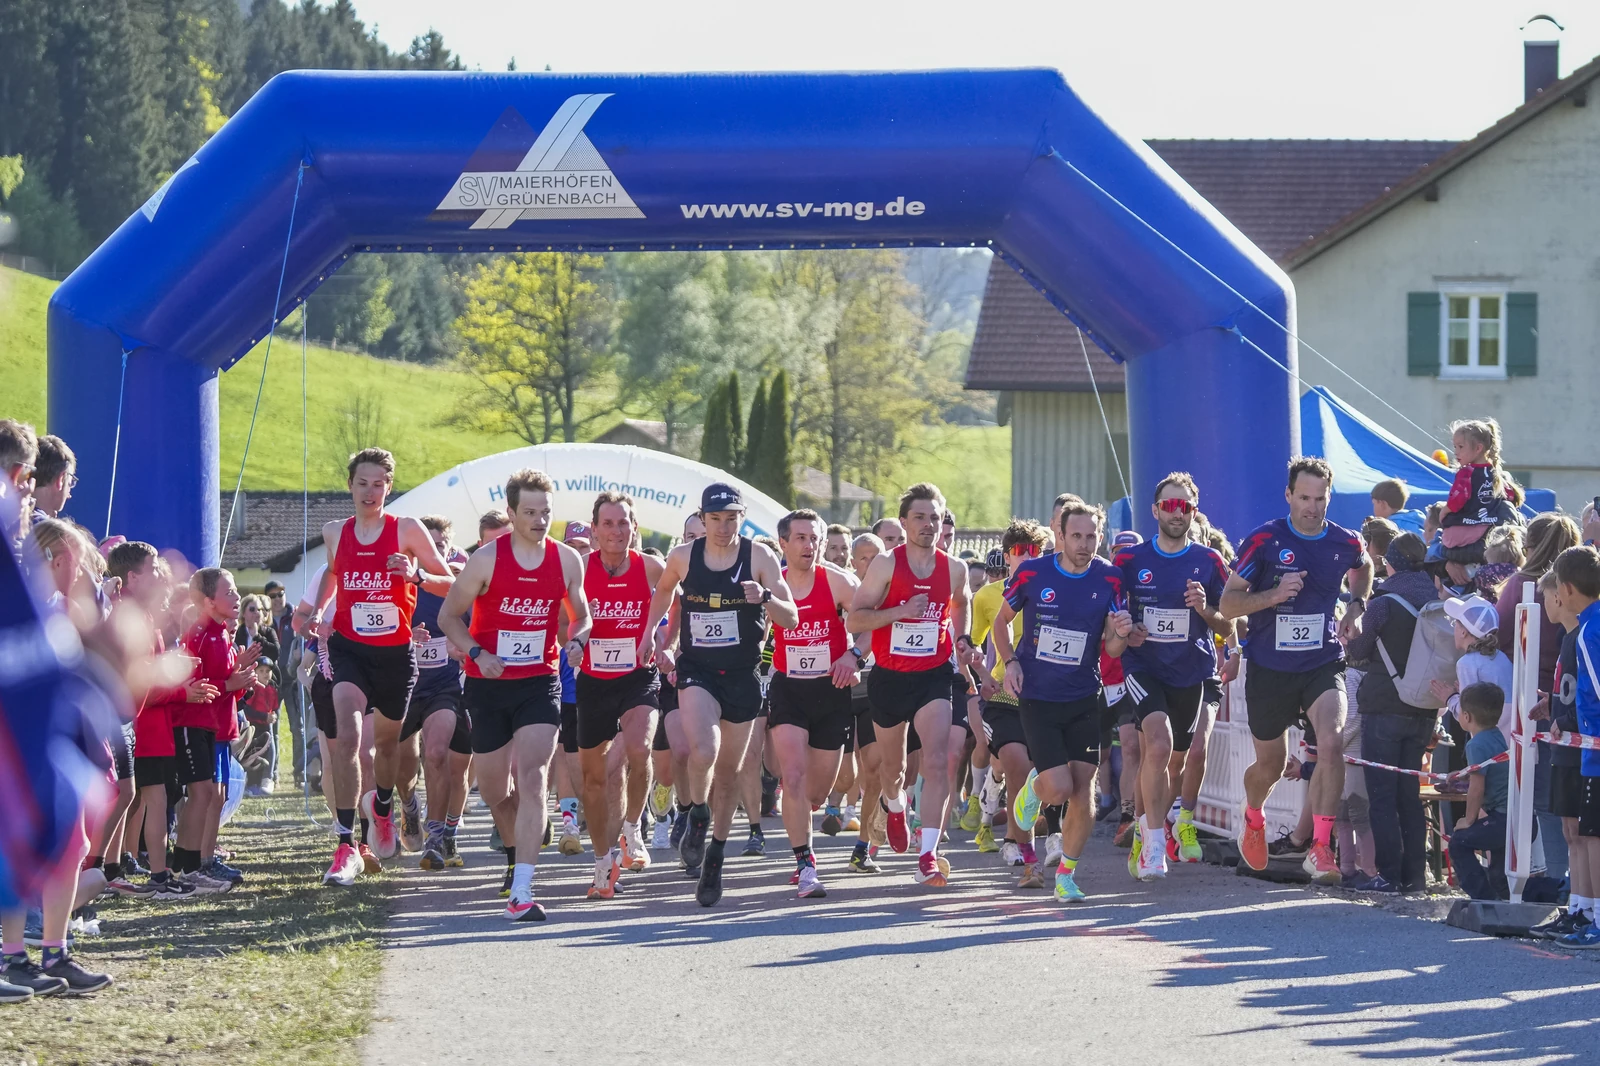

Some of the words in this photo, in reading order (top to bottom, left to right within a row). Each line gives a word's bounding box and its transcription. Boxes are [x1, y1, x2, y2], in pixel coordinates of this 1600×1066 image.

[500, 173, 612, 189] MAIERHÖFEN
[459, 176, 498, 206] SV
[497, 192, 616, 205] GRÜNENBACH
[680, 196, 926, 221] www.sv-mg.de
[565, 474, 686, 508] willkommen!
[343, 571, 392, 580] SPORT
[343, 580, 392, 588] HASCHKO
[366, 590, 393, 601] Team
[502, 597, 554, 606] SPORT
[499, 603, 550, 614] HASCHKO
[593, 601, 643, 610] SPORT
[593, 609, 642, 617] HASCHKO
[366, 614, 384, 626] 38
[521, 616, 548, 626] Team
[615, 619, 640, 629] Team
[1157, 620, 1174, 632] 54
[705, 624, 722, 637] 28
[783, 628, 830, 638] HASCHKO
[1292, 627, 1310, 640] 32
[906, 634, 924, 647] 42
[513, 642, 531, 655] 24
[1052, 640, 1069, 654] 21
[421, 648, 438, 659] 43
[604, 650, 621, 662] 77
[800, 657, 816, 669] 67
